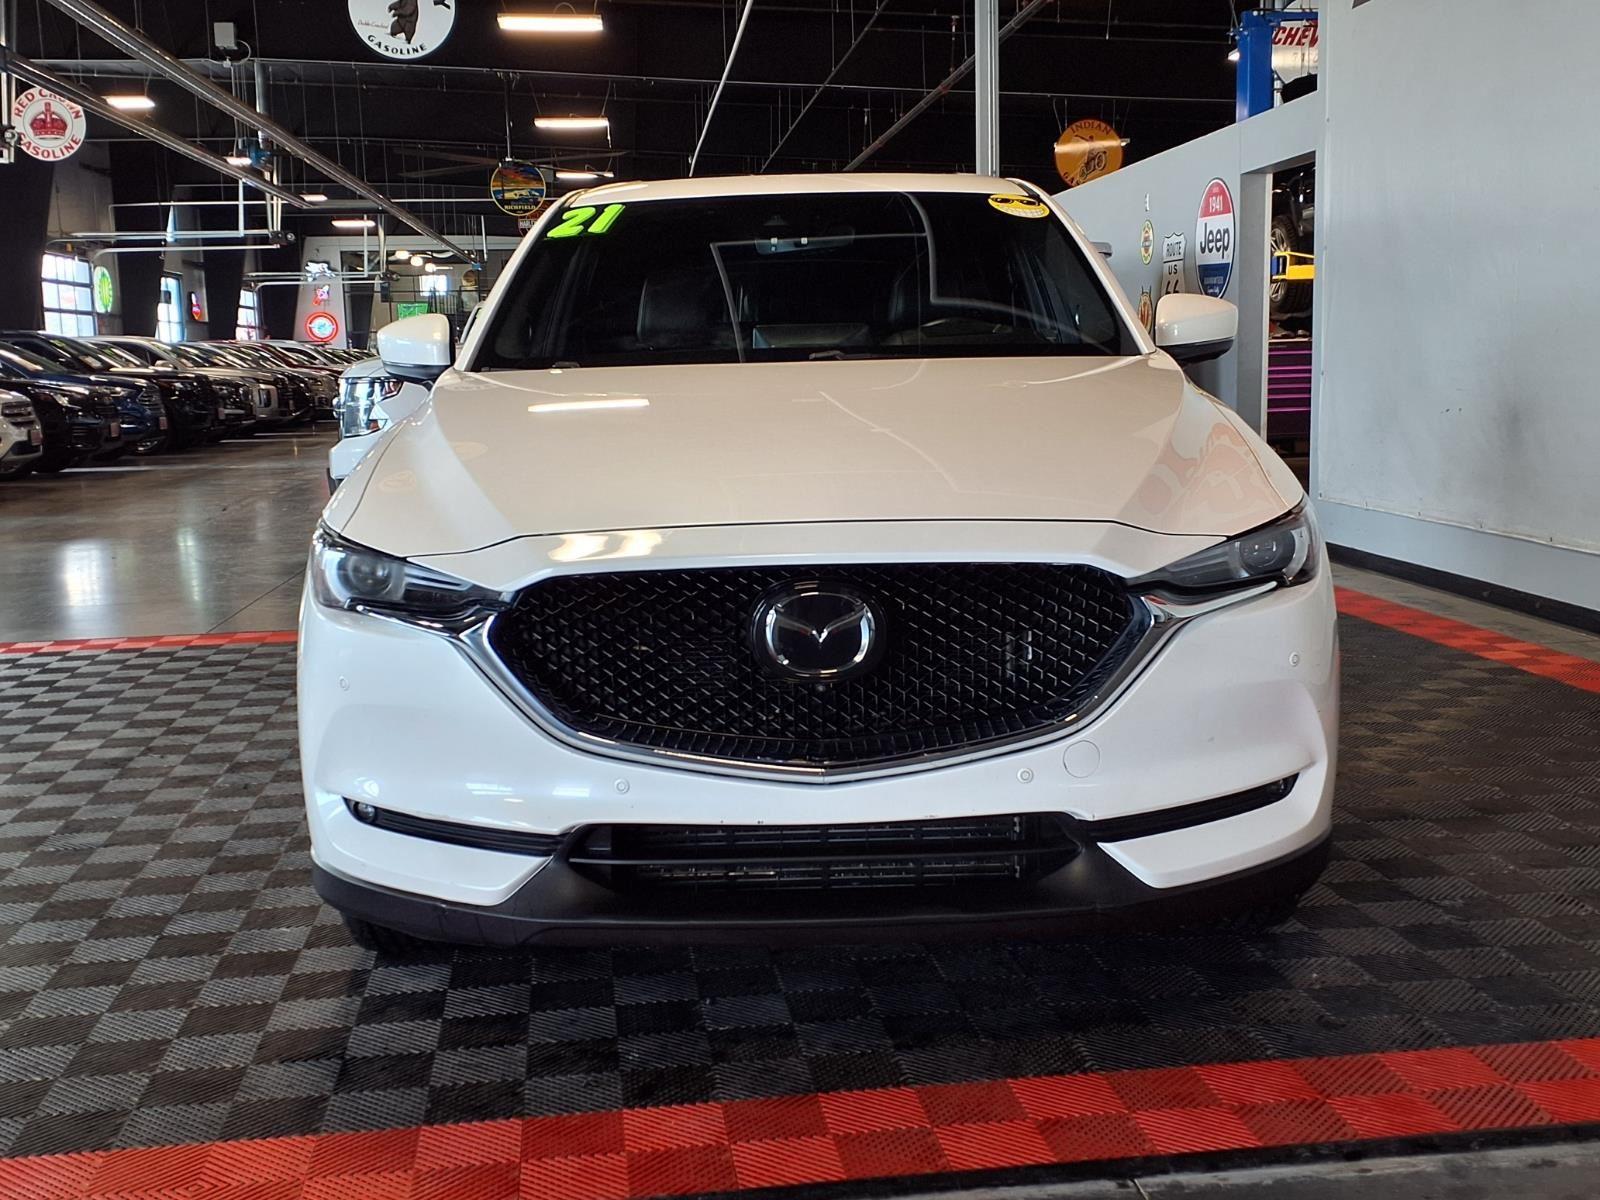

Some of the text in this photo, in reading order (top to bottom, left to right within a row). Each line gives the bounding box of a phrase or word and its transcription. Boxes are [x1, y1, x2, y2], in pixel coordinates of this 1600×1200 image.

[367, 35, 427, 55] GASOLINE
[14, 92, 35, 118] RED
[1070, 121, 1112, 136] INDIAN
[1209, 194, 1223, 213] 1941
[546, 204, 625, 238] 21
[1166, 241, 1182, 257] ROUTE
[1200, 222, 1231, 260] Jeep
[1168, 264, 1178, 275] US
